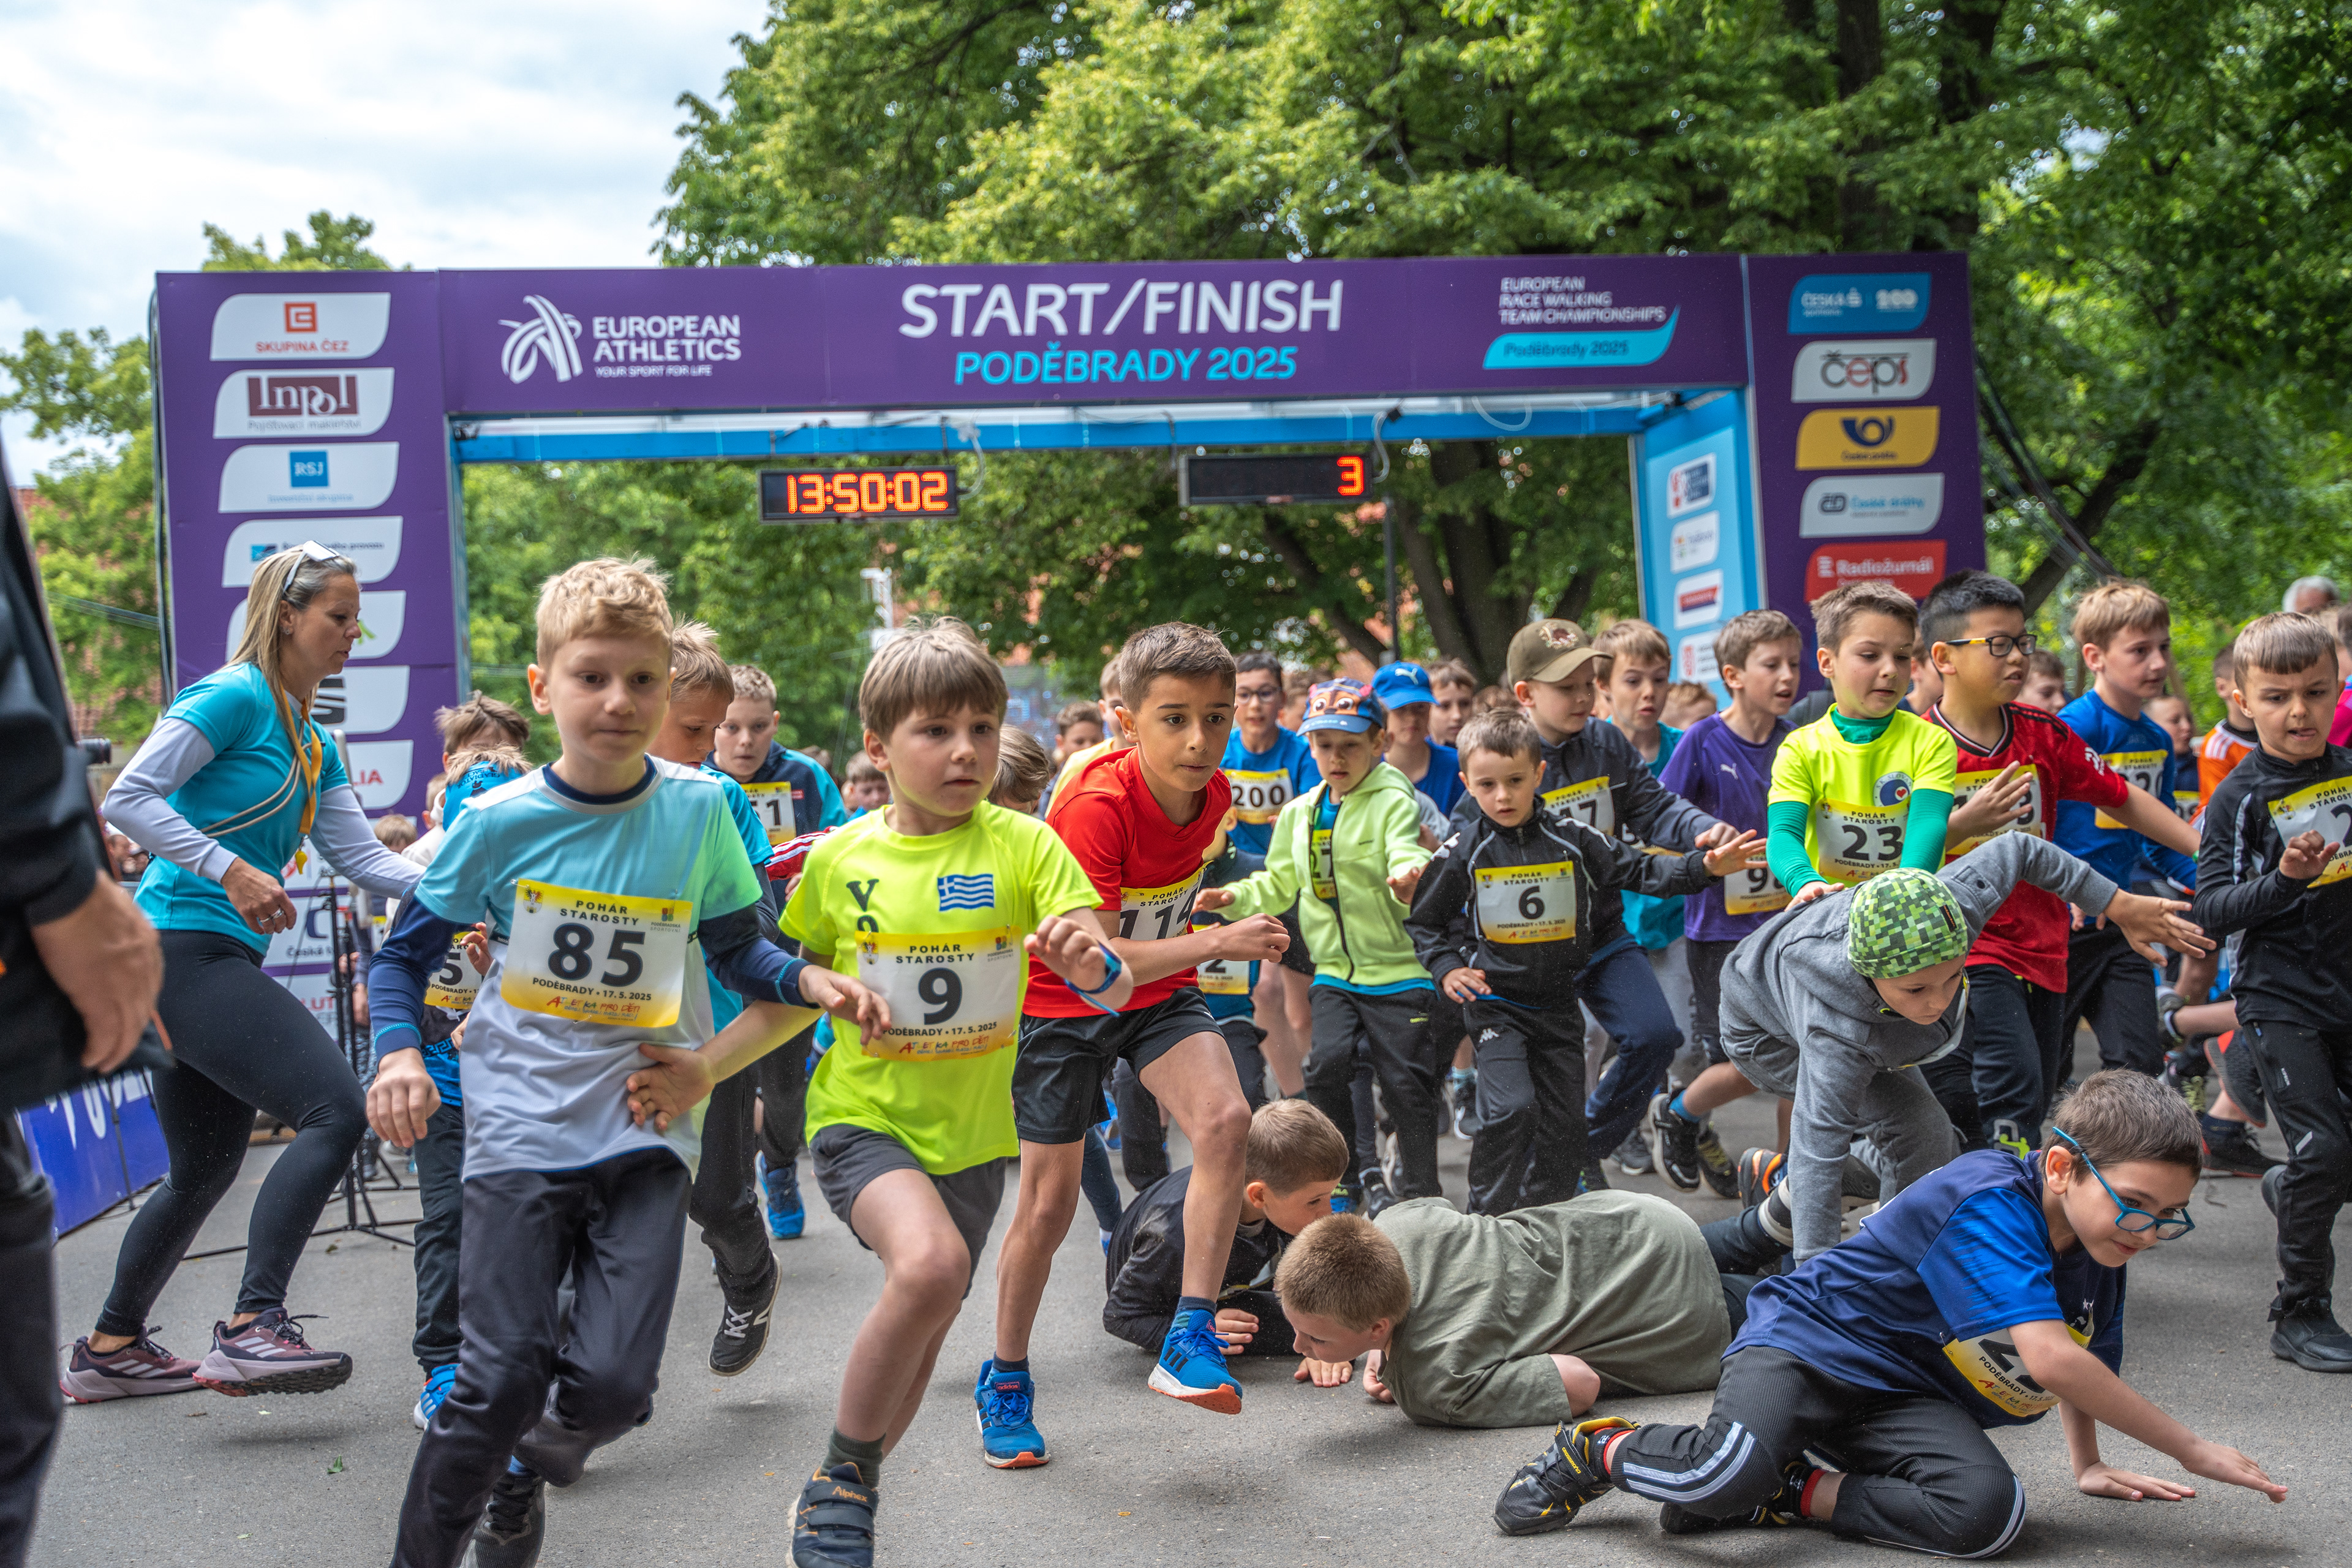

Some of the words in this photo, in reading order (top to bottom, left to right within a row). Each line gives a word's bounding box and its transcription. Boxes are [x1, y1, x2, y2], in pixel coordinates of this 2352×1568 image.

[1501, 276, 1586, 293] EUROPEAN
[899, 277, 1344, 338] START/FINISH
[1499, 293, 1542, 309] RACE
[1543, 291, 1613, 307] WALKING
[1499, 308, 1542, 325] TEAM
[1542, 306, 1666, 324] CHAMPIONSHIPS
[593, 314, 741, 339] EUROPEAN
[256, 341, 317, 353] SKUPINA
[320, 338, 349, 352] ČEZ
[593, 339, 742, 363] ATHLETICS
[595, 366, 627, 378] YOUR
[628, 365, 665, 377] SPORT
[666, 365, 688, 377] FOR
[690, 364, 713, 377] LIFE
[954, 341, 1201, 385] PODĚBRADY
[1206, 346, 1298, 380] 2025
[294, 462, 324, 477] RSJ
[1337, 456, 1364, 496] 3
[787, 472, 948, 514] 13:50:02
[1232, 784, 1286, 808] 200
[2316, 786, 2348, 799] POHÁR
[1843, 816, 1896, 825] STAROSTY
[1842, 824, 1904, 862] 23
[1834, 858, 1875, 869] PODĚBRADY
[1504, 876, 1550, 886] STAROSTY
[1140, 889, 1189, 907] STAROSTY
[1152, 887, 1184, 900] POHÁR
[1518, 885, 1545, 920] 6
[575, 900, 628, 914] POHÁR
[560, 908, 639, 926] STAROSTY
[548, 922, 646, 987] 85
[910, 943, 961, 953] POHÁR
[895, 953, 975, 964] STAROSTY
[431, 984, 469, 994] PODĚBRADY
[532, 976, 595, 996] PODĚBRADY
[603, 990, 617, 1000] 17.
[619, 991, 627, 1000] 5.
[629, 992, 652, 1001] 2025
[918, 967, 962, 1025] 9
[600, 1003, 619, 1012] PRO
[978, 1021, 998, 1032] 2025
[951, 1039, 970, 1048] PRO
[1978, 1355, 2027, 1395] PODĚBRADY
